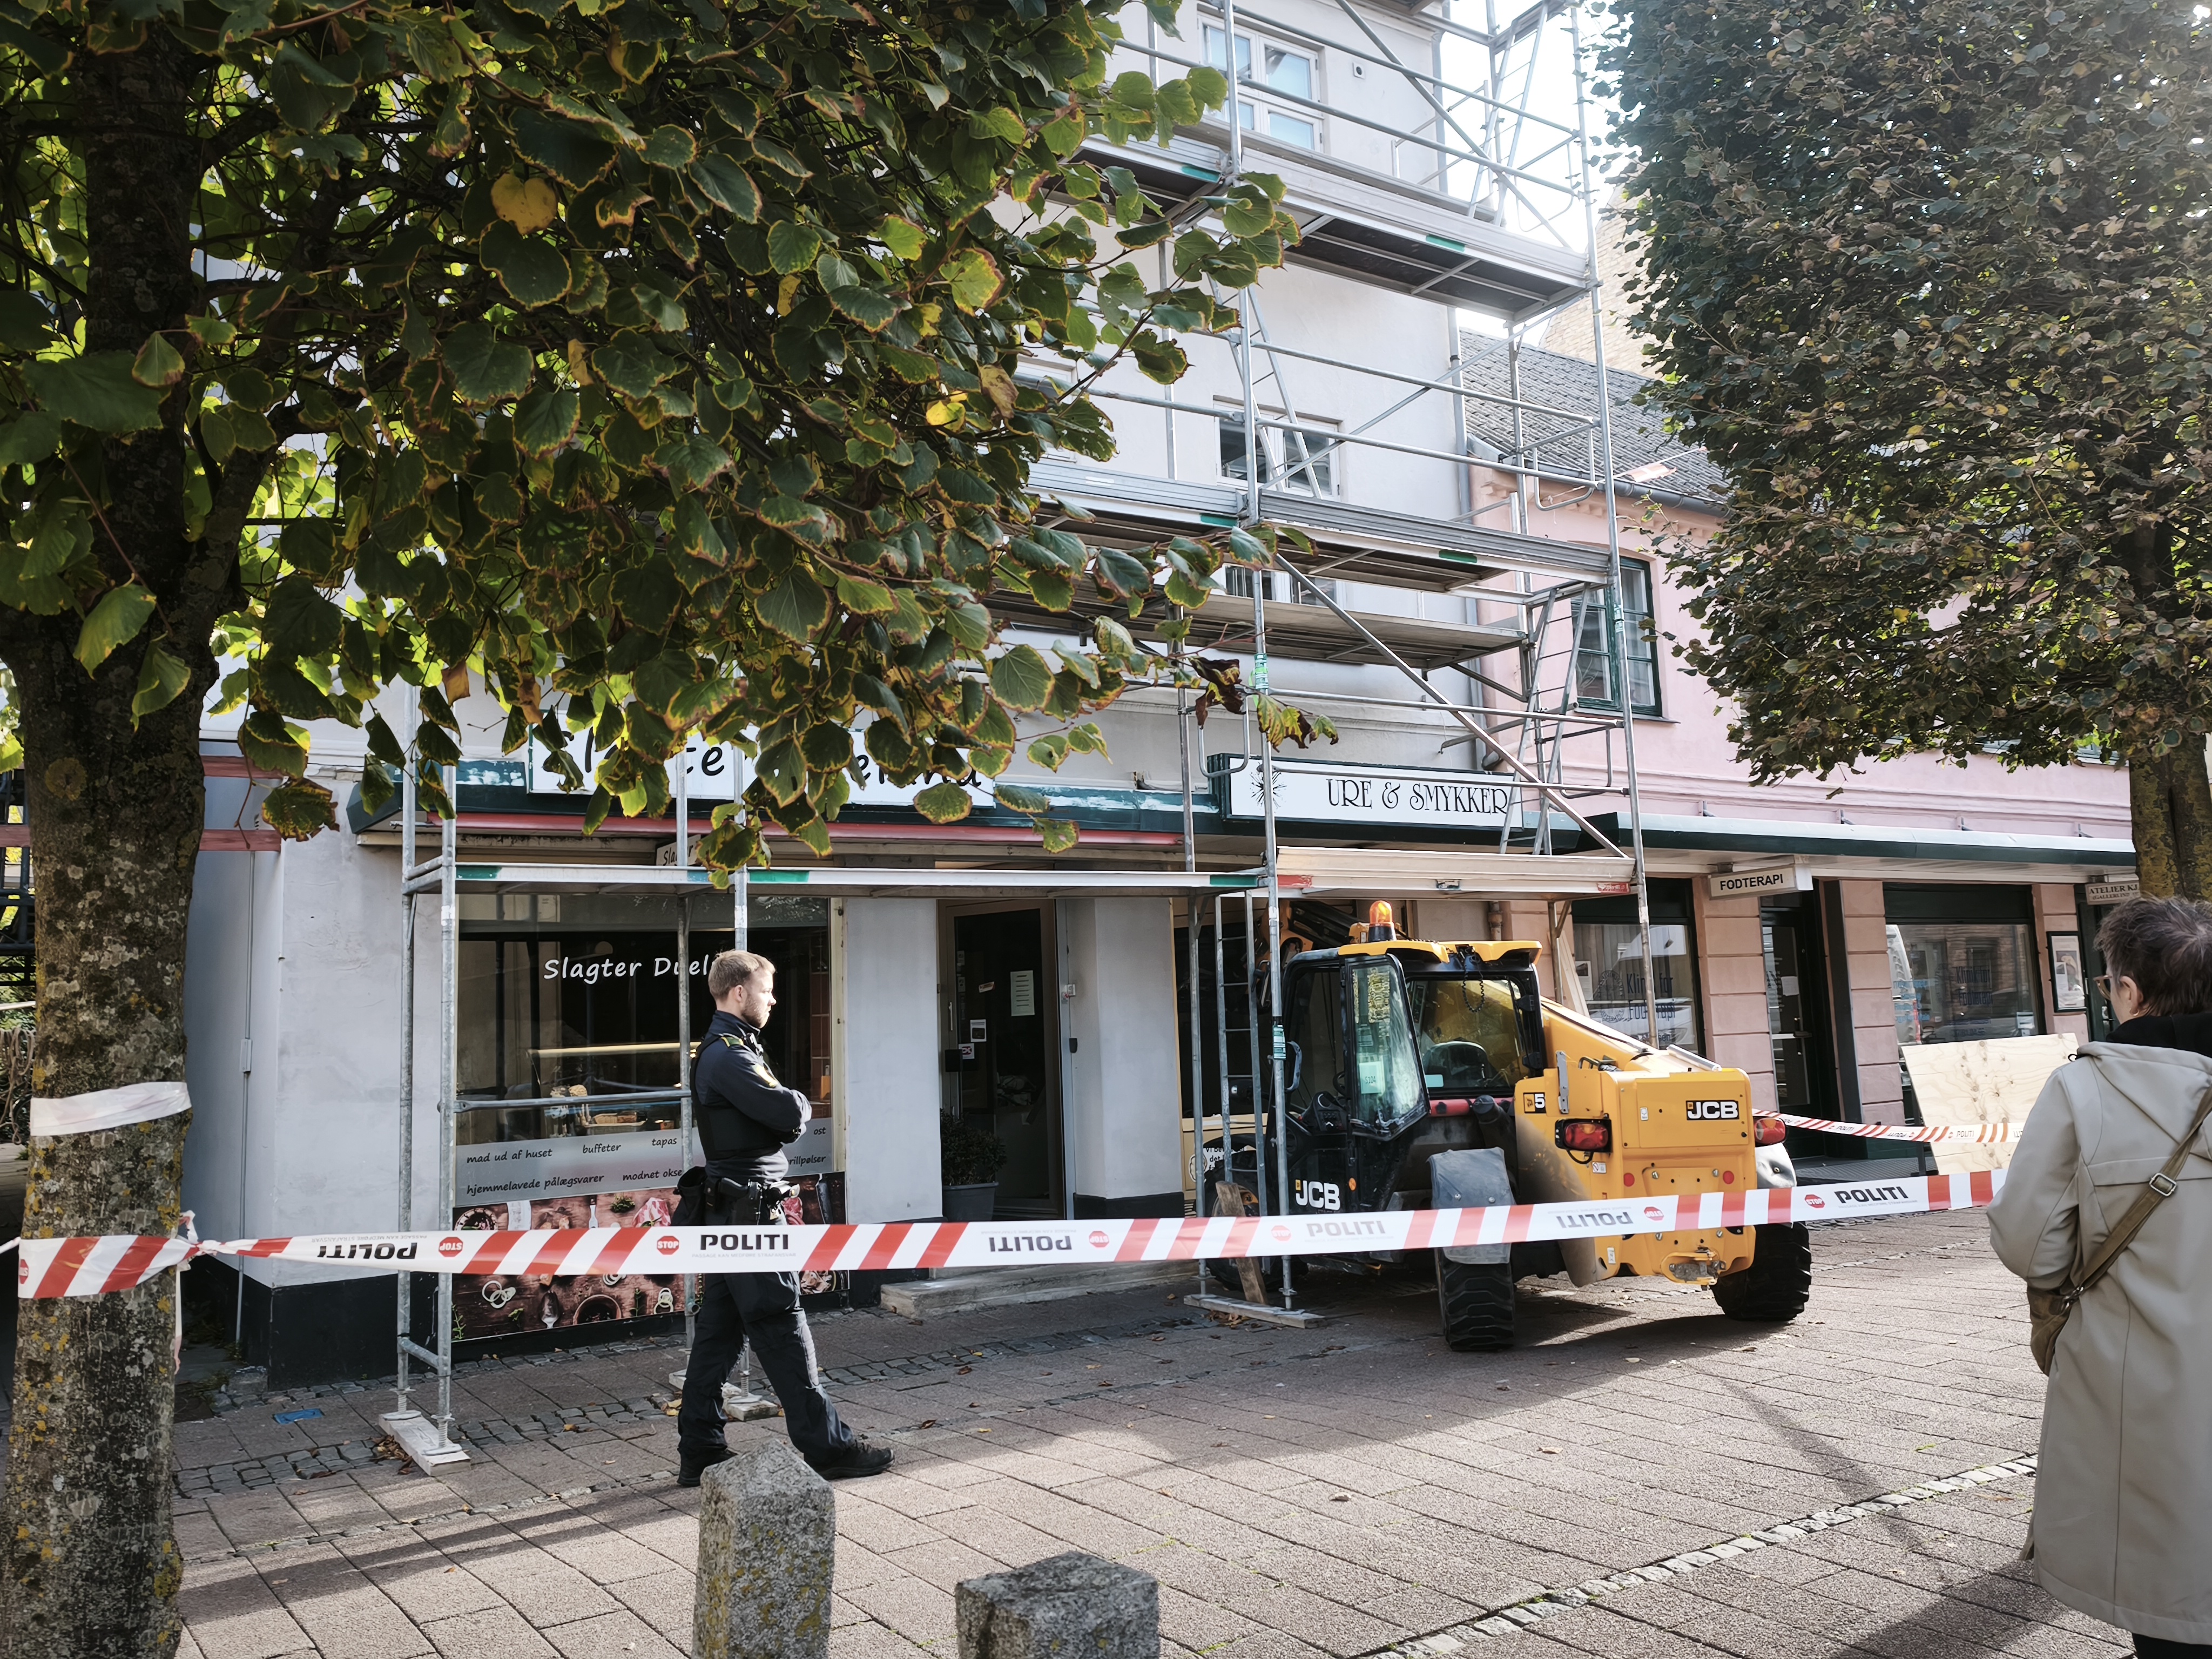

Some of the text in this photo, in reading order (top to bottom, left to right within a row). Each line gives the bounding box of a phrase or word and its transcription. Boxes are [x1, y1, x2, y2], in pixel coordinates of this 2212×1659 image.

[1326, 779, 1507, 814] URE & SMYKKER
[1720, 874, 1783, 891] FODTERAPI
[2089, 885, 2126, 894] ATELIER
[544, 956, 642, 984] Slagter
[1659, 973, 1673, 994] for
[1687, 1101, 1738, 1119] JCB
[583, 1143, 621, 1154] buffeter
[652, 1137, 677, 1148] tapas
[467, 1149, 552, 1163] mad ud af huset
[788, 1155, 826, 1167] rillpølser
[623, 1171, 659, 1181] modnet
[467, 1175, 604, 1197] hjemmelavede pålægsvarer
[1296, 1180, 1340, 1211] JCB
[1834, 1186, 1908, 1204] POLITI
[1306, 1220, 1386, 1237] POLITI
[1556, 1211, 1634, 1229] POLITI
[317, 1242, 463, 1259] POLITI STOP
[657, 1234, 788, 1250] STOP POLITI
[989, 1236, 1072, 1252] POLITI
